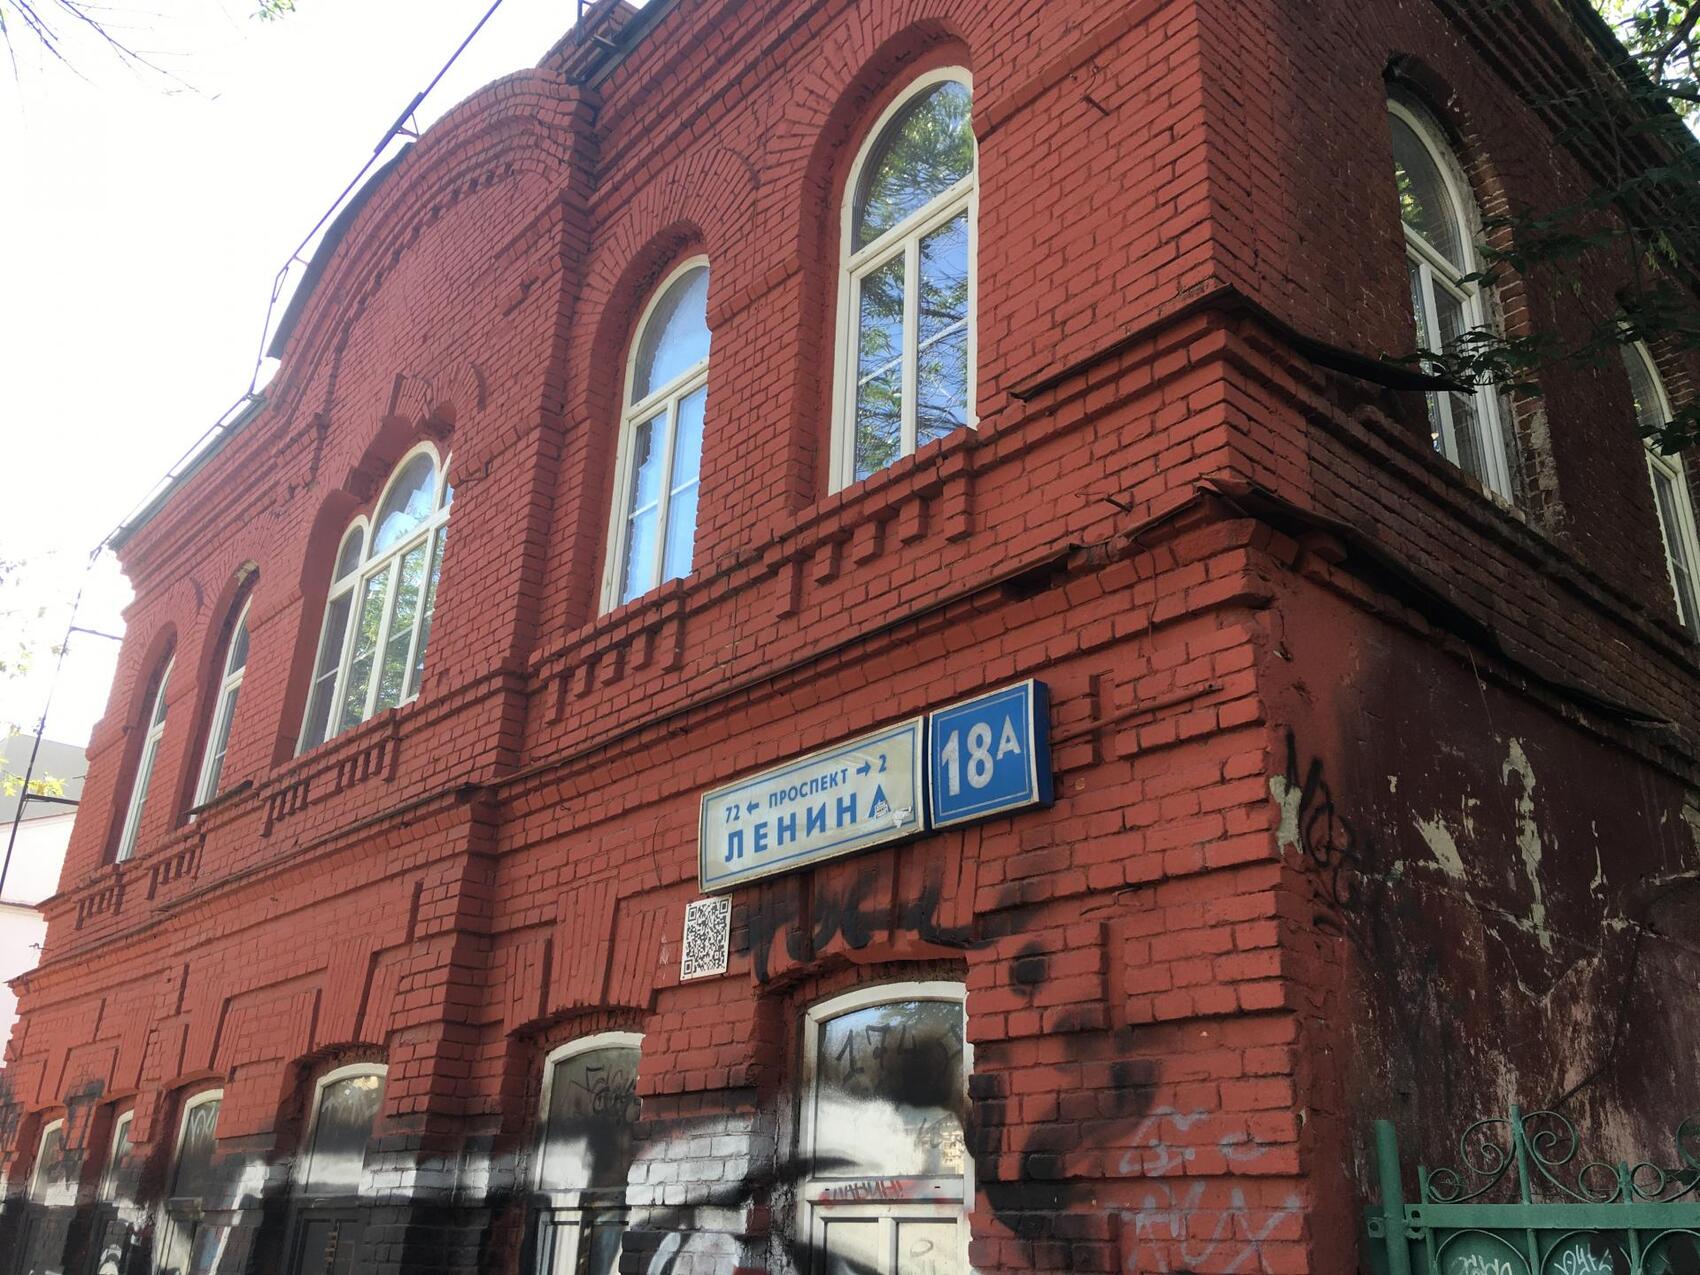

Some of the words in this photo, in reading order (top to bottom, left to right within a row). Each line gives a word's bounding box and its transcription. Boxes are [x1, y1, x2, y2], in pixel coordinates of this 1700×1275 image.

[725, 801, 740, 823] 72
[769, 768, 848, 808] ПРОСПЕКТ
[879, 754, 888, 774] 2
[942, 714, 1021, 797] 18А
[724, 784, 892, 862] ЛЕНИНА
